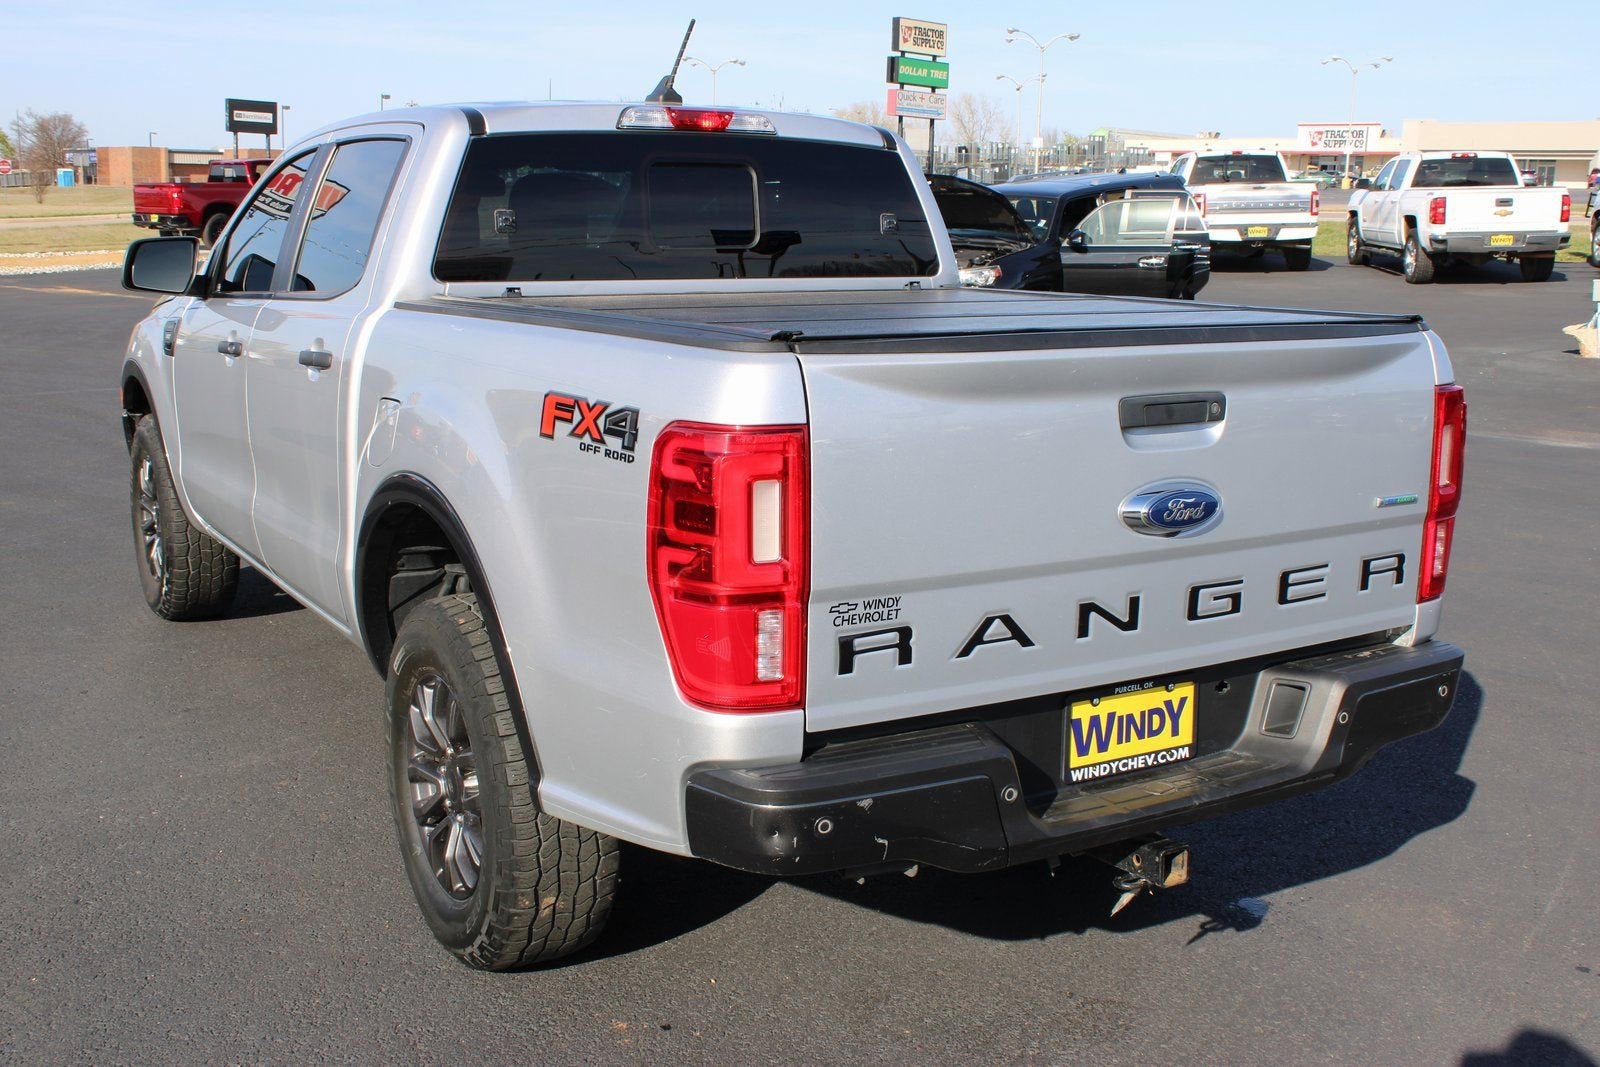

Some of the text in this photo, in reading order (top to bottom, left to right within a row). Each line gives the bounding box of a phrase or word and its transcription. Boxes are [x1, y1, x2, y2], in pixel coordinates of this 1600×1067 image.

[913, 26, 945, 40] TRACTOR
[912, 36, 937, 49] SUPPLY
[899, 65, 948, 80] DOLLAR TREE
[897, 91, 945, 105] Quick Care
[1323, 139, 1353, 148] SUPPY
[539, 390, 641, 452] FX4
[579, 441, 635, 464] OFF ROAD
[1163, 497, 1206, 522] Ford
[862, 595, 902, 611] WINDY
[832, 608, 902, 628] CHEVROLET
[837, 552, 1406, 676] RANGER
[1114, 681, 1154, 694] PURCELL, OK
[1070, 696, 1188, 758] WINDY
[1070, 746, 1190, 782] WINDYCHEV.COM
